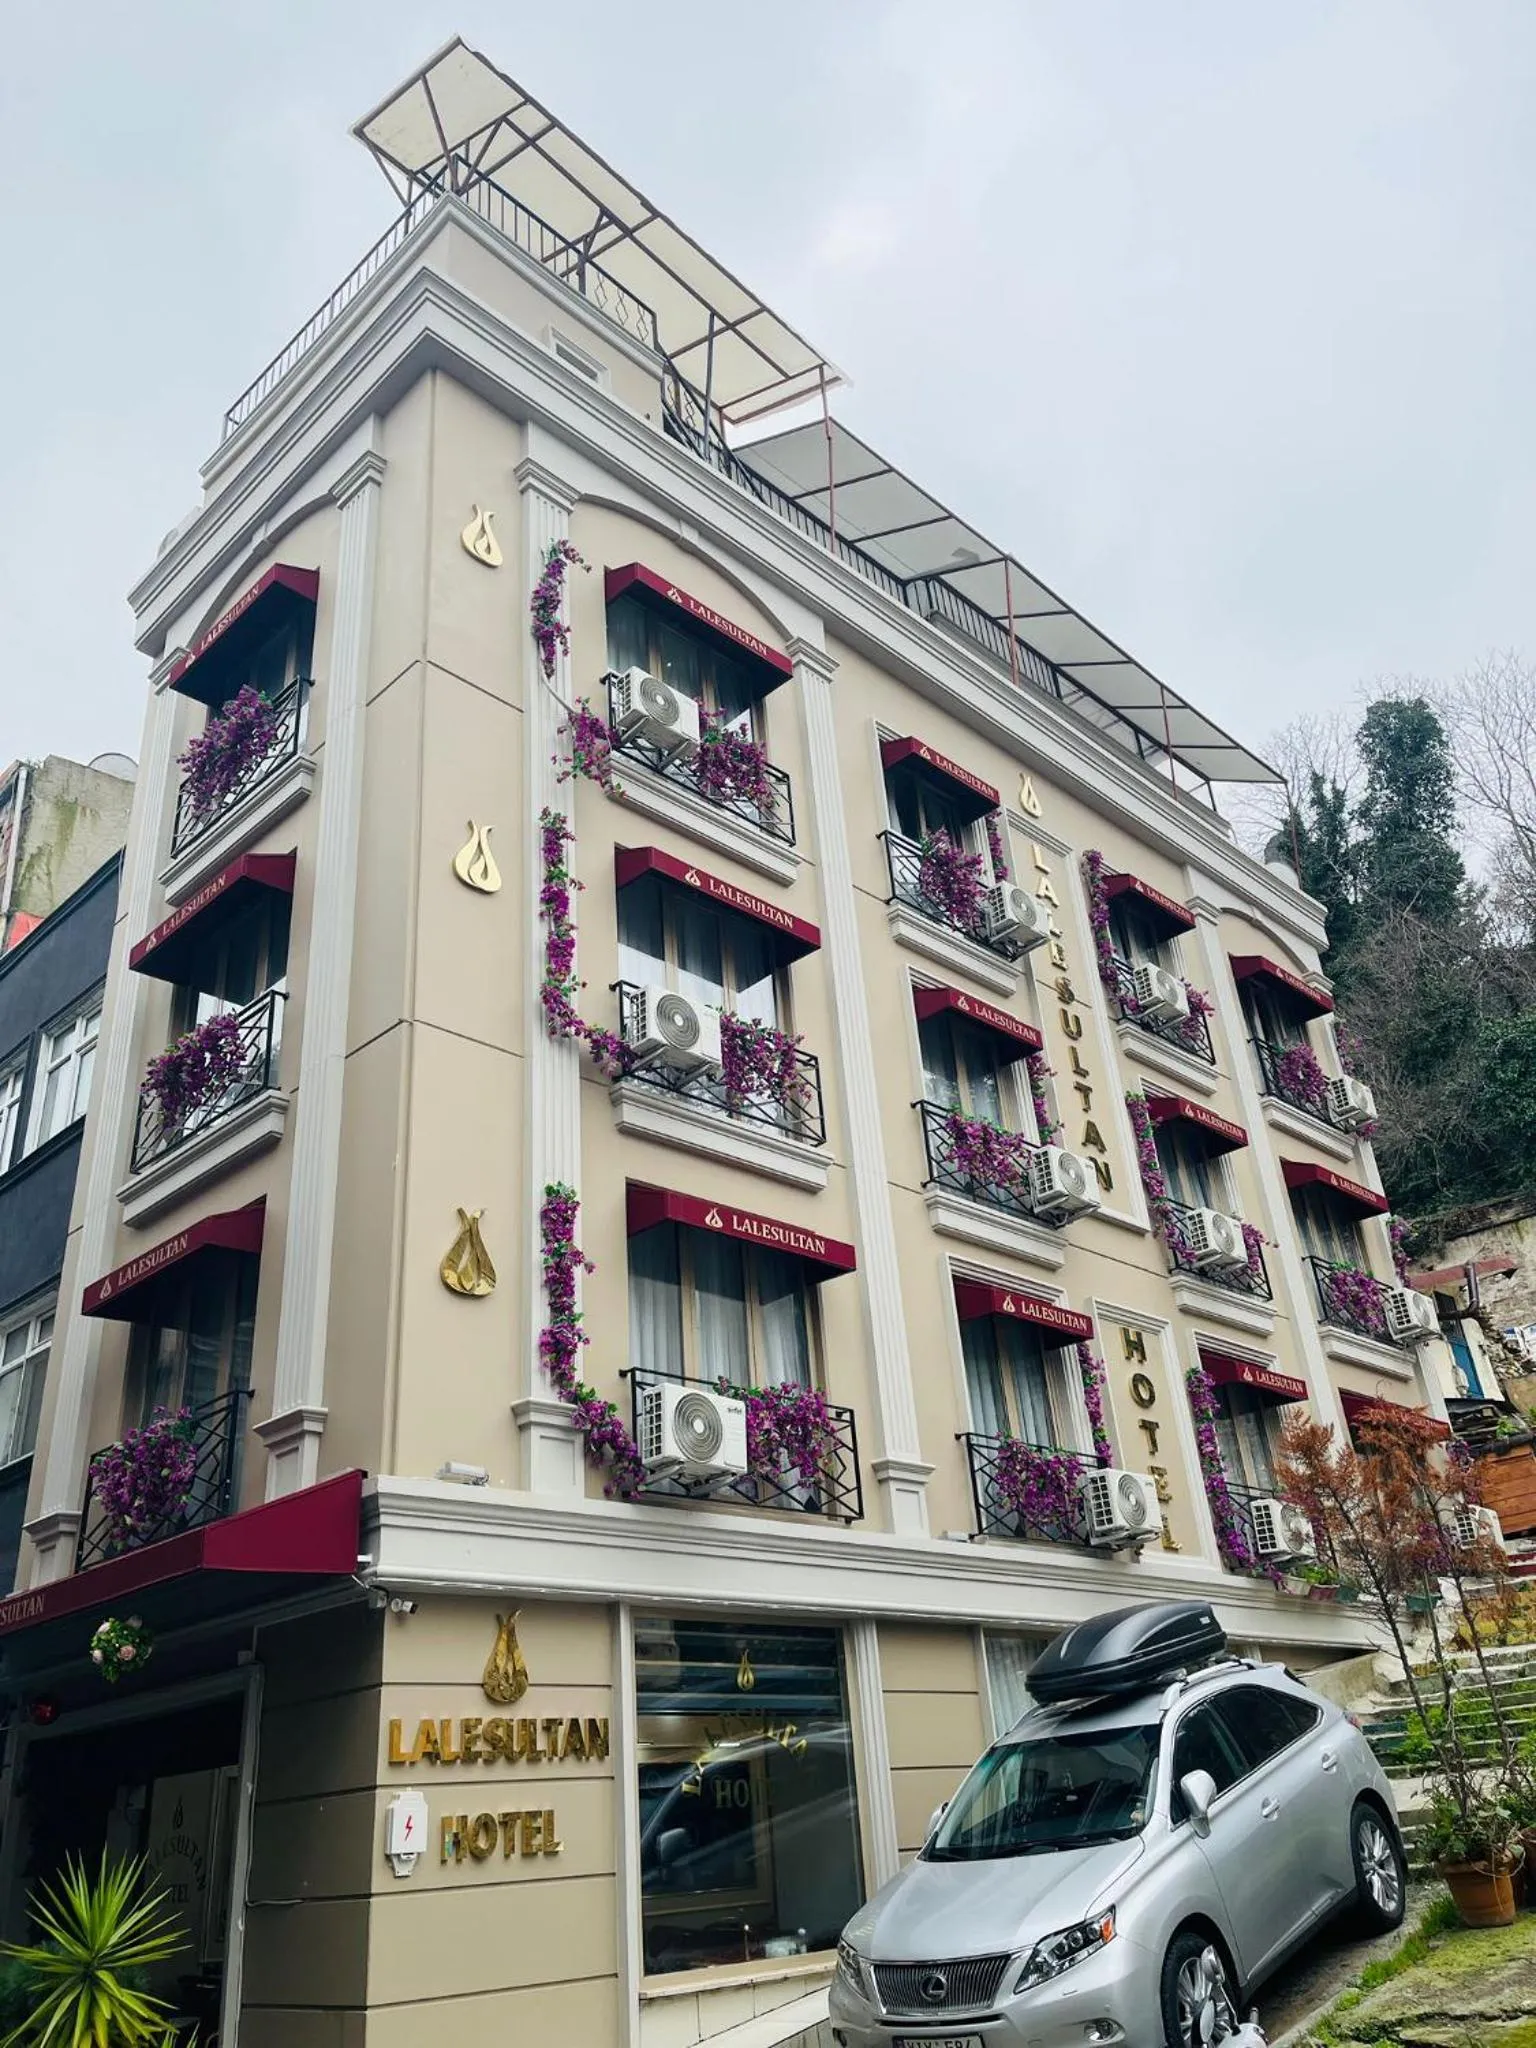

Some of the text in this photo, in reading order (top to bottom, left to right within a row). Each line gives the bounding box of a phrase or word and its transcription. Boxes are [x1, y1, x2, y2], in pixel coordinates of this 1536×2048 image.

[690, 599, 768, 657] LALESULTAN
[936, 753, 996, 799] LALESULTAN
[163, 873, 227, 935] LALESULTAN
[709, 878, 794, 929] LALESULTAN
[974, 1002, 1037, 1042] LALESULTAN
[118, 1233, 189, 1286] LALESULTAN
[732, 1213, 826, 1256] LALESULTAN
[1021, 1299, 1088, 1332] LALESULTAN
[1119, 1327, 1182, 1552] HOTEL
[388, 1717, 611, 1764] LALESULTAN
[439, 1809, 564, 1864] HOTEL
